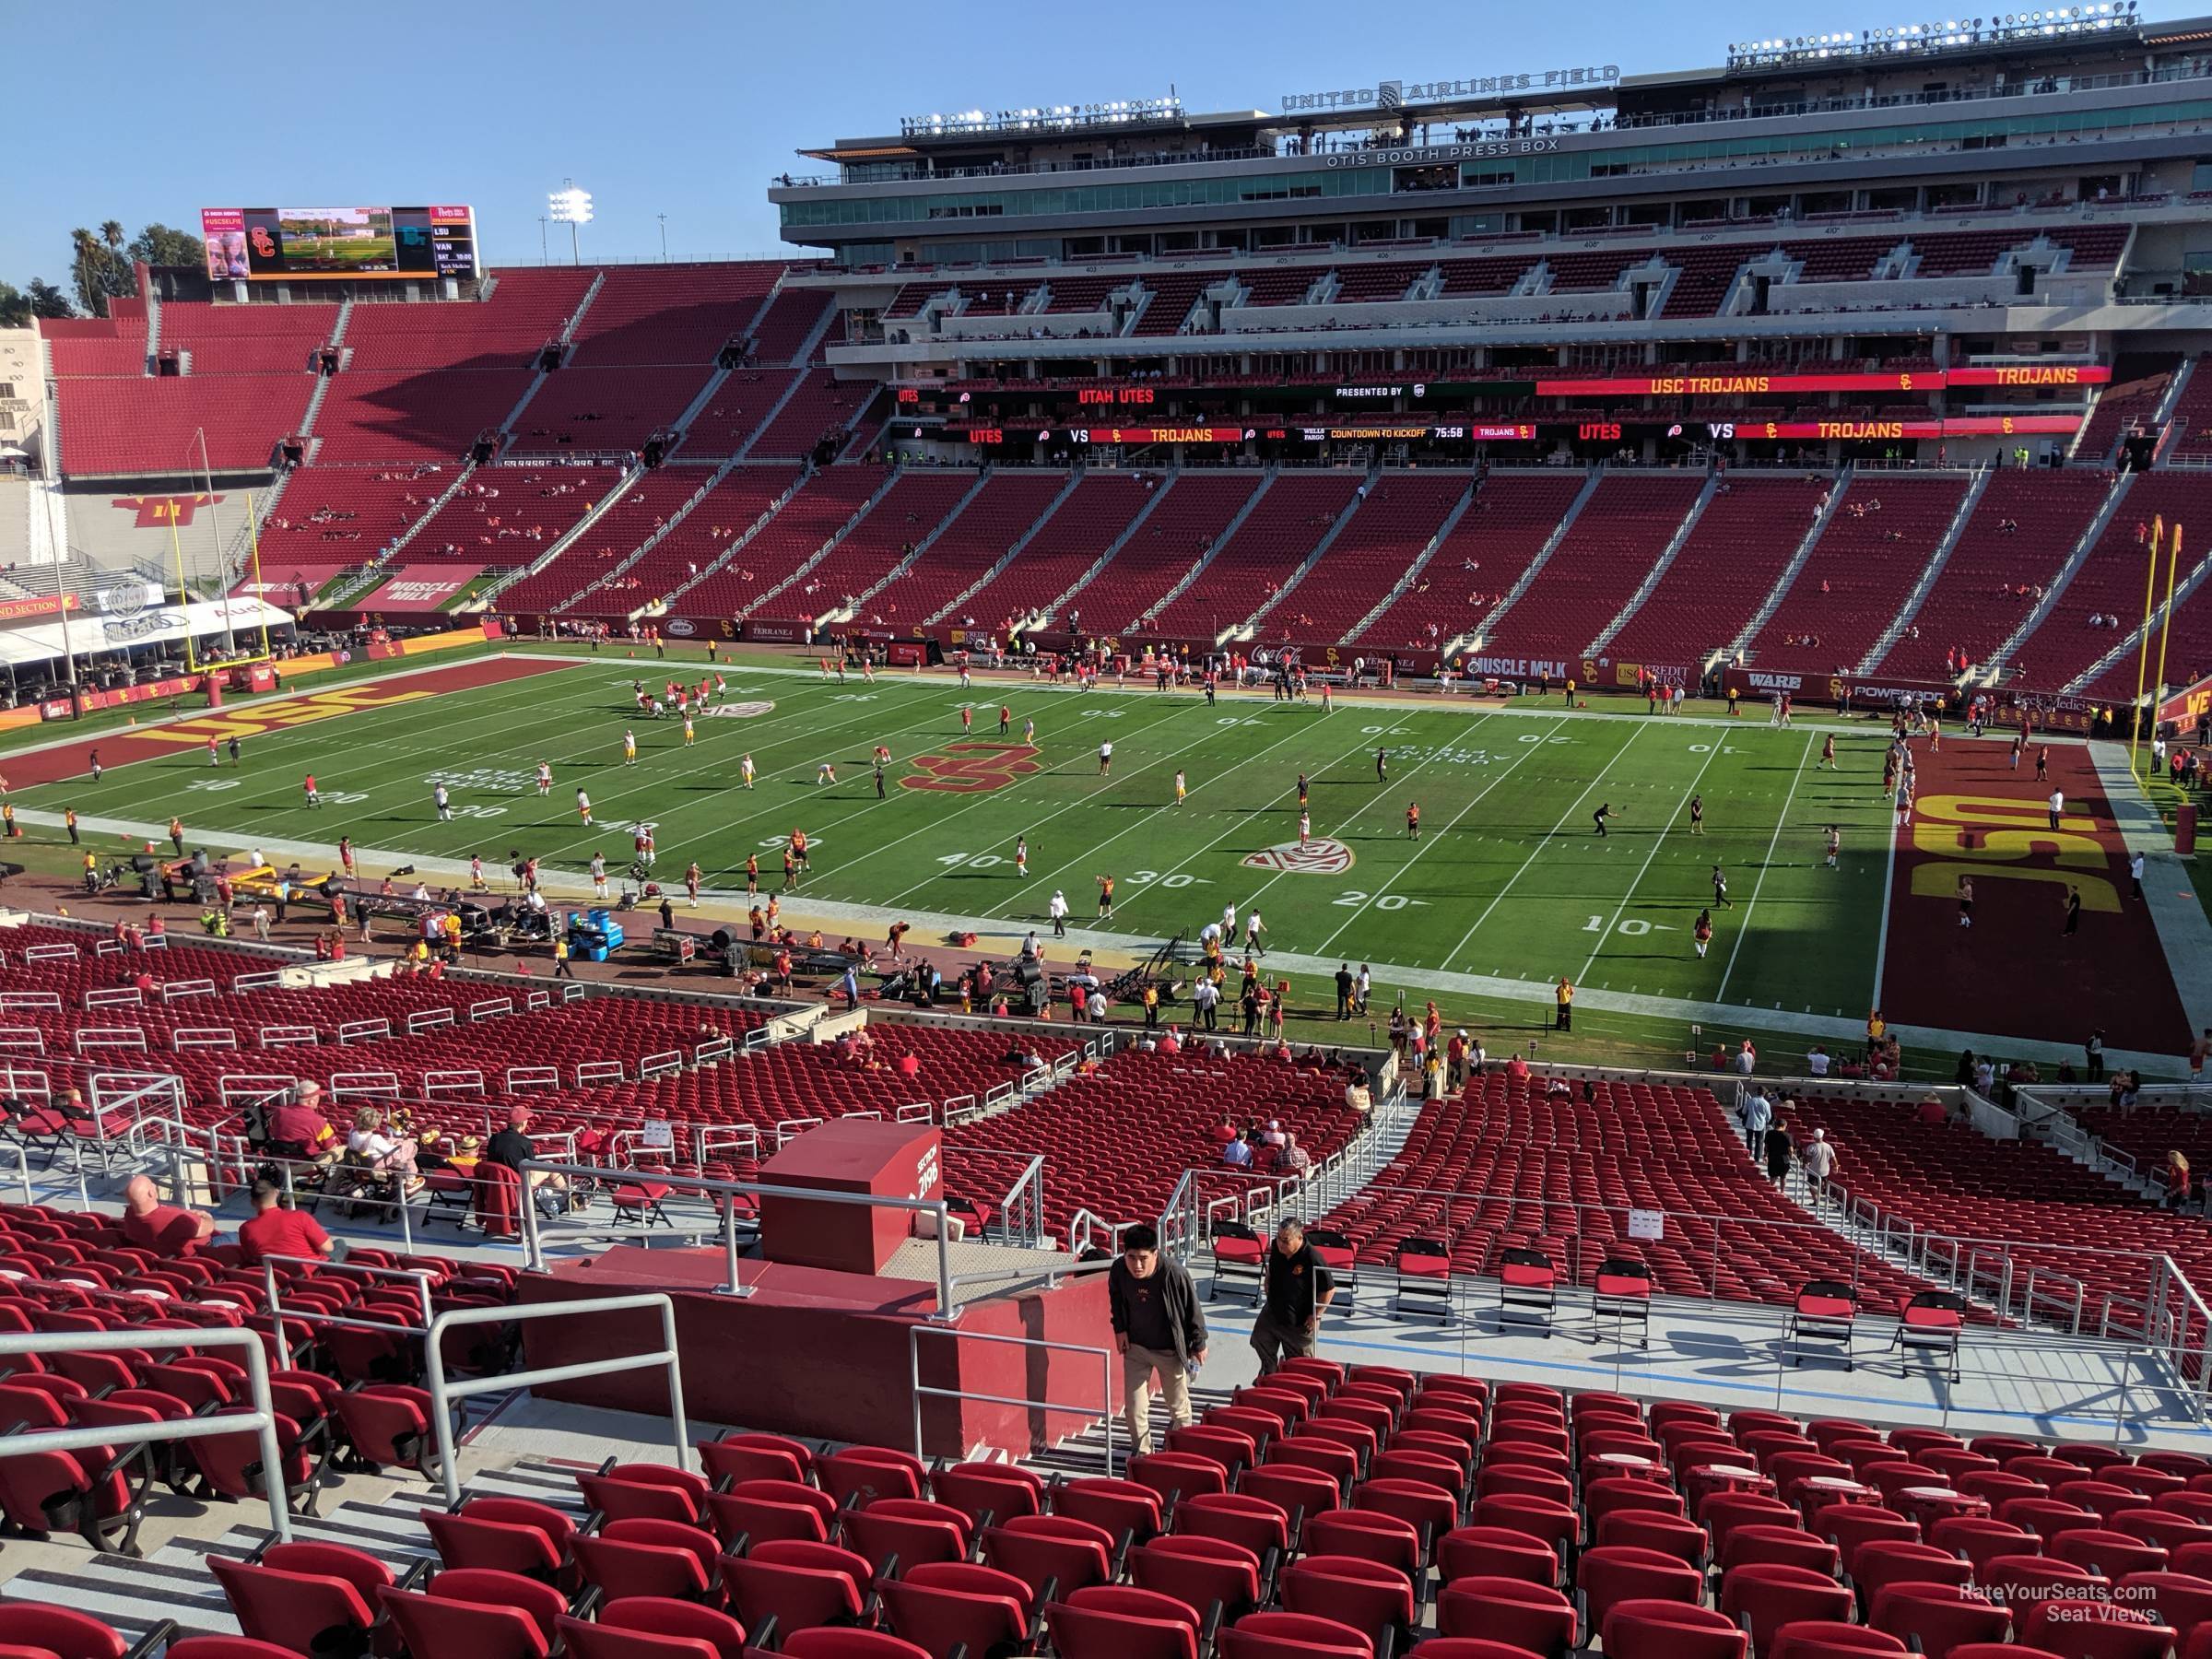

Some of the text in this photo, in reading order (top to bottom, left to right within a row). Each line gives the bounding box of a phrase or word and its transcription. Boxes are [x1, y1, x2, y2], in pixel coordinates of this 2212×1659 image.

[1282, 65, 1620, 110] UNITED AIRLINES FIELD
[1327, 139, 1560, 167] OTIS BOOTH PRESS BOX
[252, 228, 275, 256] SC
[1996, 369, 2077, 383] TROJANS
[1336, 387, 1402, 397] PRESENTED BY
[1651, 377, 1769, 394] USC TROJANS
[899, 390, 919, 403] UTES
[1079, 390, 1153, 404] UTAH UTES
[970, 429, 1003, 443] UTES
[1071, 429, 1088, 442] VS
[1151, 429, 1213, 442] TROJANS
[1267, 430, 1285, 439] UTES
[1331, 429, 1426, 439] COUNTDOWN TO KICKOFF
[1435, 428, 1463, 438] 75:58
[1480, 428, 1514, 437] TROJANS
[1580, 424, 1621, 440] UTES
[1711, 424, 1734, 438] VS
[1818, 423, 1902, 438] TROJANS
[387, 582, 461, 592] MUSCLE
[388, 591, 439, 600] MILK
[214, 600, 271, 618] Audi
[721, 620, 733, 637] SC
[752, 628, 794, 636] TERRANEA
[1471, 657, 1526, 677] MUSCLE
[1531, 660, 1567, 678] MILK
[1583, 661, 1597, 683] SC
[1748, 674, 1802, 689] WARE
[2187, 690, 2211, 714] WE
[123, 688, 440, 743] USC
[1080, 710, 1126, 718] 50
[1360, 725, 1411, 735] 30
[1518, 735, 1571, 744] 20
[1688, 744, 1734, 754] 10
[936, 853, 1003, 867] 40
[1911, 794, 2123, 912] USC
[1125, 870, 1194, 888] 30
[1332, 890, 1408, 911] 20
[1581, 914, 1651, 935] 10
[917, 1143, 937, 1174] SECTION
[918, 1161, 938, 1200] 219B
